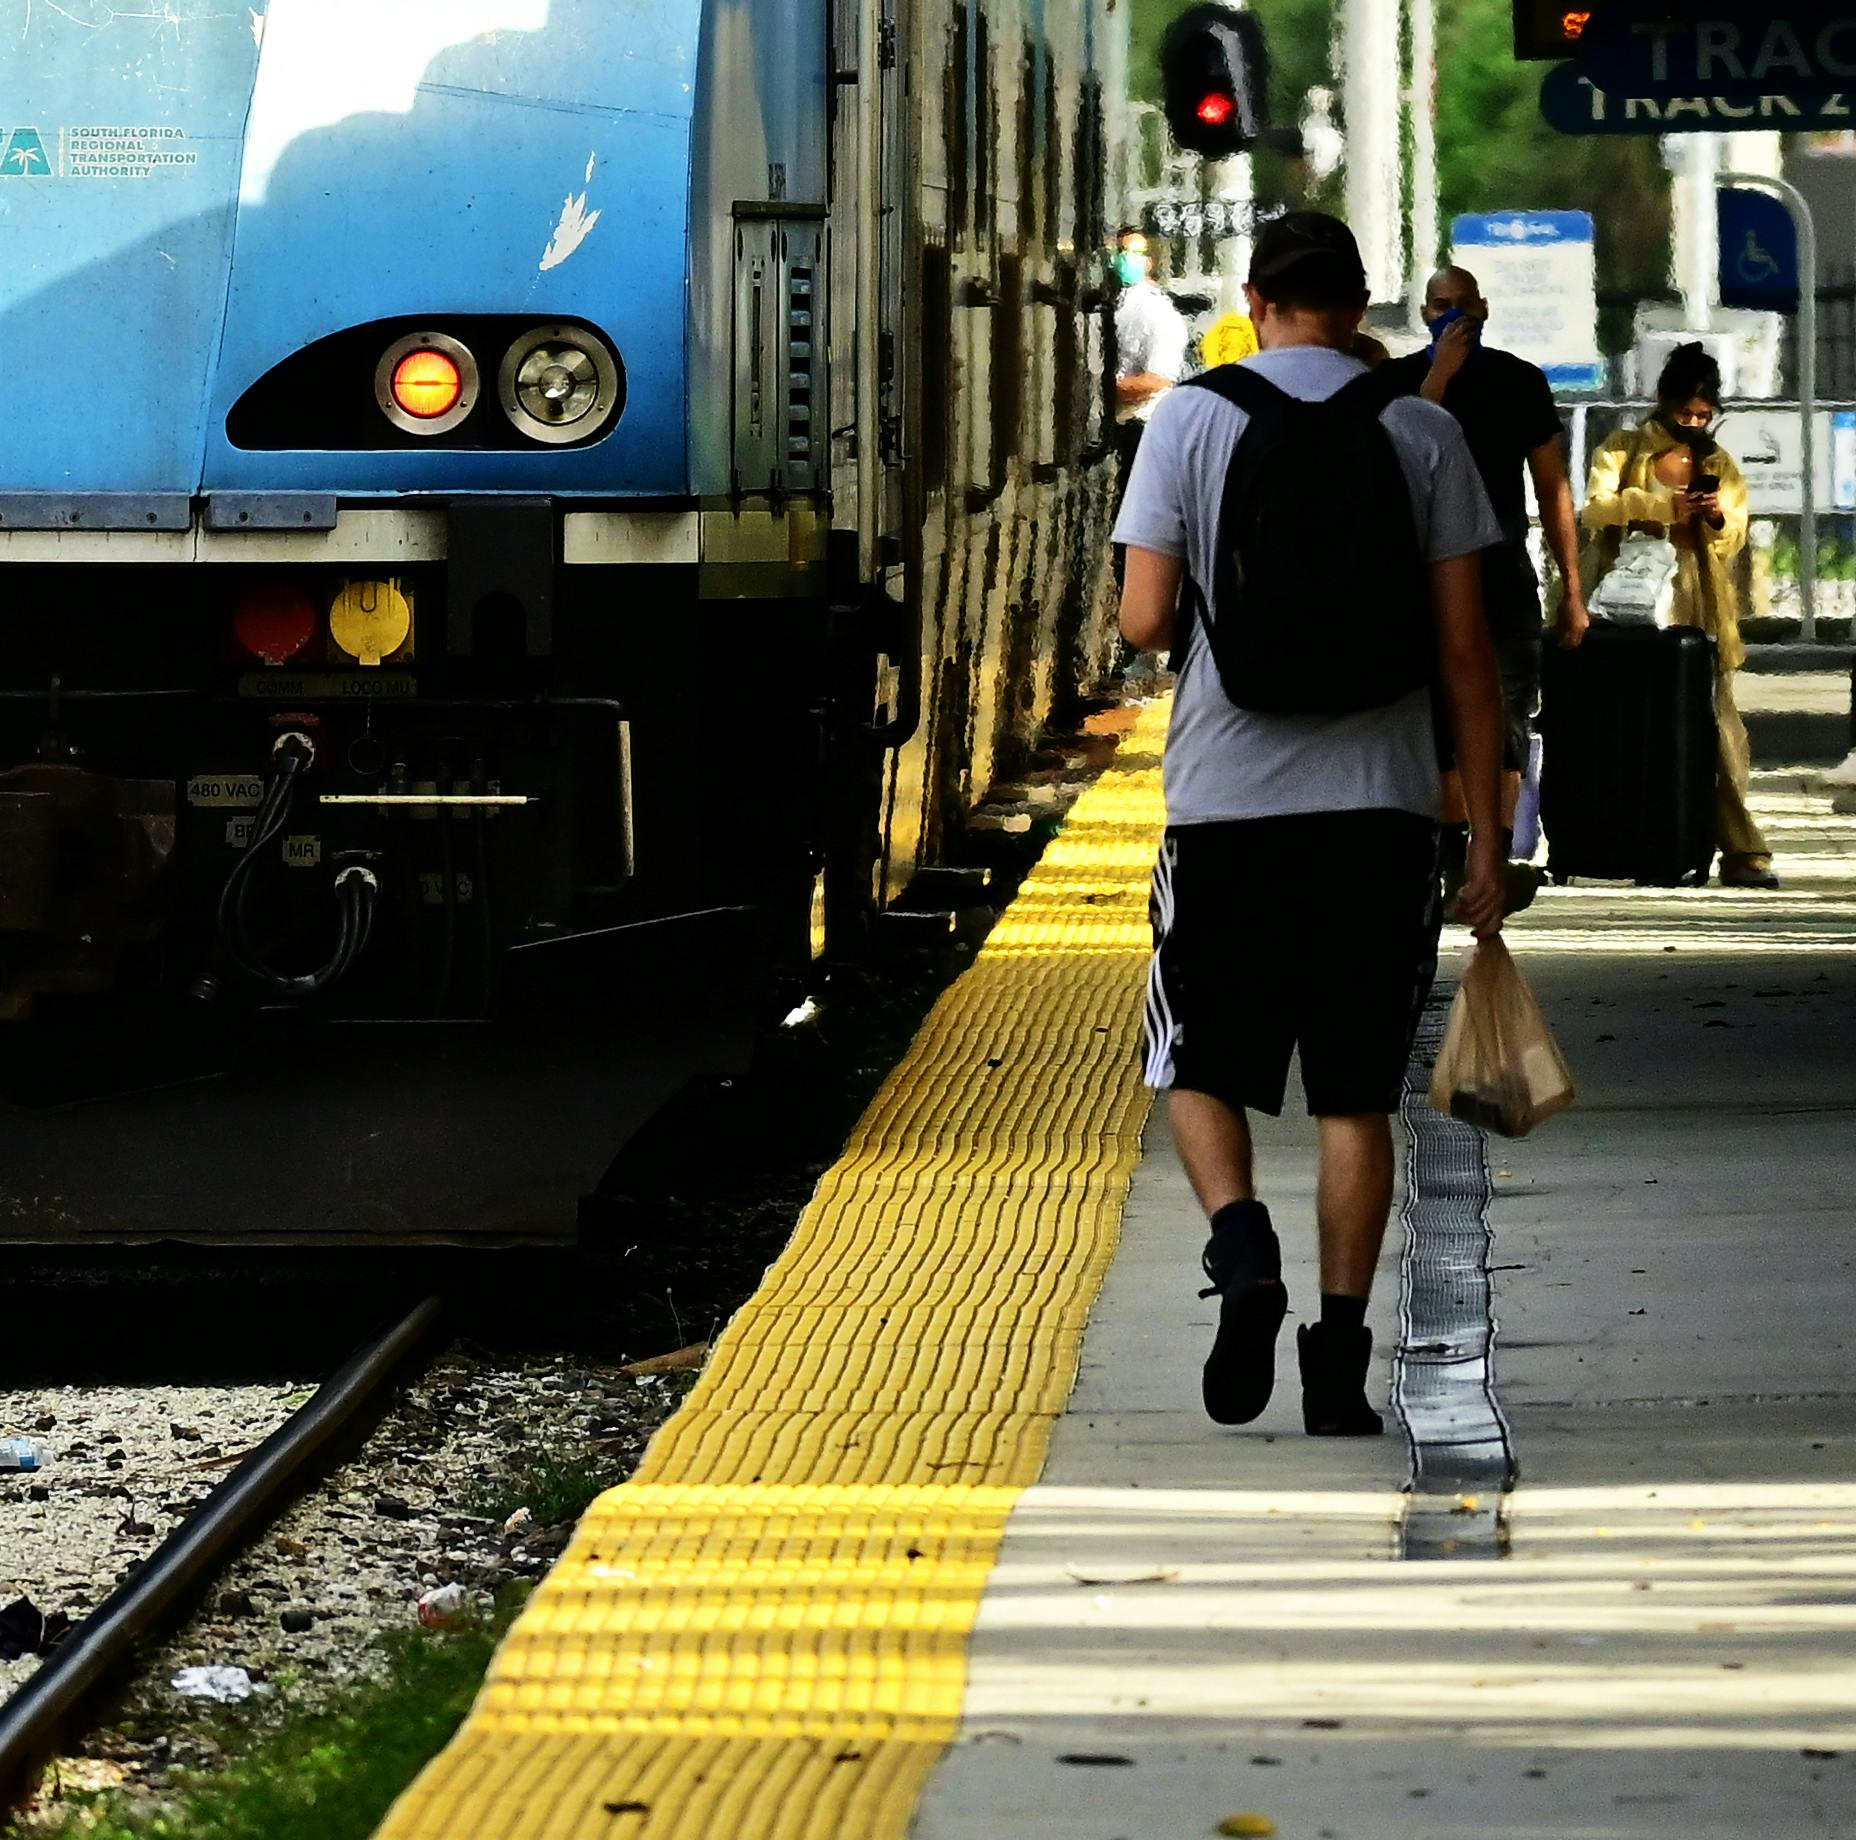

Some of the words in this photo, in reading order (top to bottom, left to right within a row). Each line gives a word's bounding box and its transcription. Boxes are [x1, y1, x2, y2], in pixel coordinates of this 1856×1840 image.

[70, 127, 118, 138] SOUTH
[121, 127, 184, 138] FLORIDA
[71, 140, 145, 150] REGIONAL
[70, 153, 196, 164] TRANSPORTATION
[71, 166, 151, 176] AUTHORITY
[256, 680, 304, 696] COMM
[191, 783, 224, 797] 480
[226, 783, 260, 797] VAC
[289, 843, 314, 858] MR
